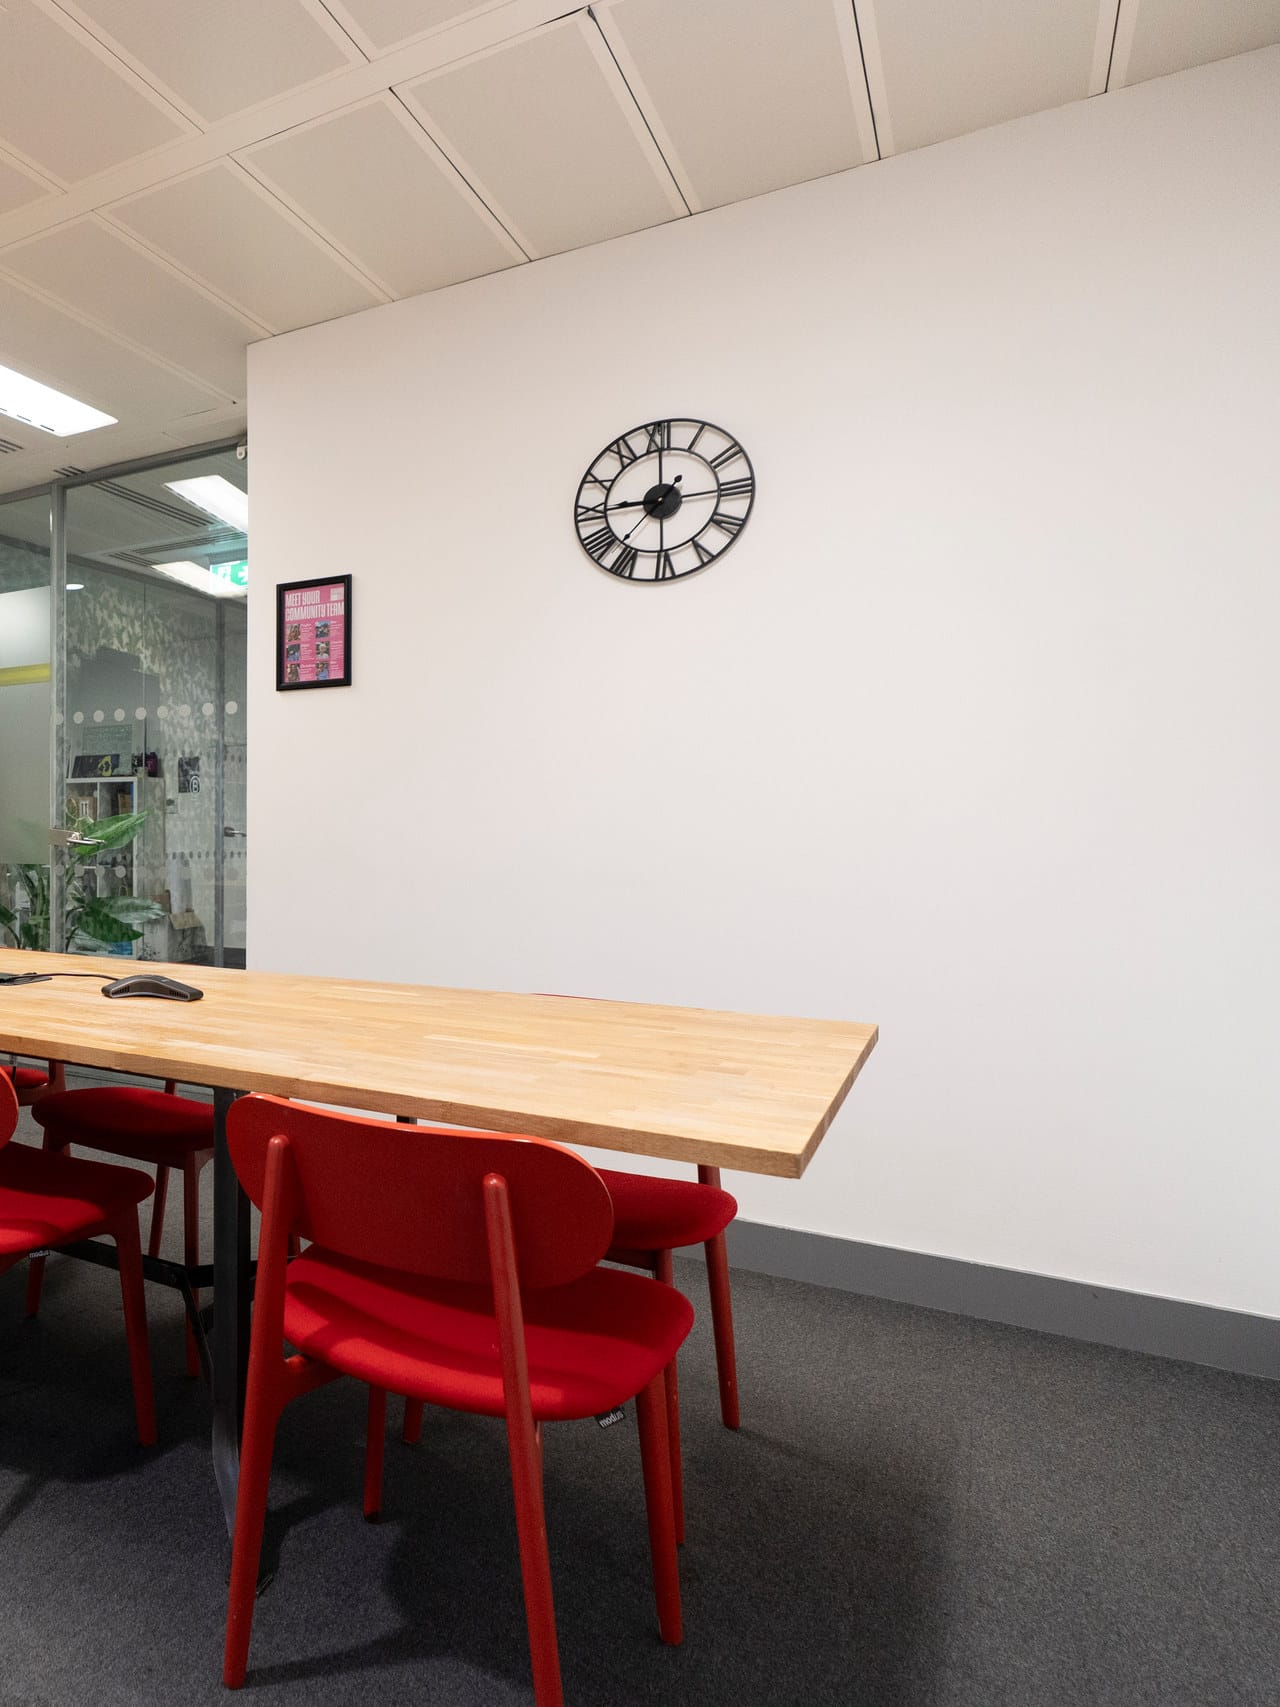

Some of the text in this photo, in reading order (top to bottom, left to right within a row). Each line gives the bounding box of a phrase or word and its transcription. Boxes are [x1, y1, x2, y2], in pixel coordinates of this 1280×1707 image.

[687, 424, 706, 450] I
[606, 438, 637, 469] XI
[709, 442, 743, 470] II
[583, 472, 614, 491] X
[719, 477, 753, 498] III
[576, 502, 606, 523] IX
[581, 526, 616, 561] VIII
[691, 538, 716, 564] V
[610, 546, 638, 578] VII
[654, 551, 676, 580] VI
[285, 592, 301, 607] MEET
[302, 590, 320, 606] YOUR
[285, 604, 326, 621] COMMUNITY
